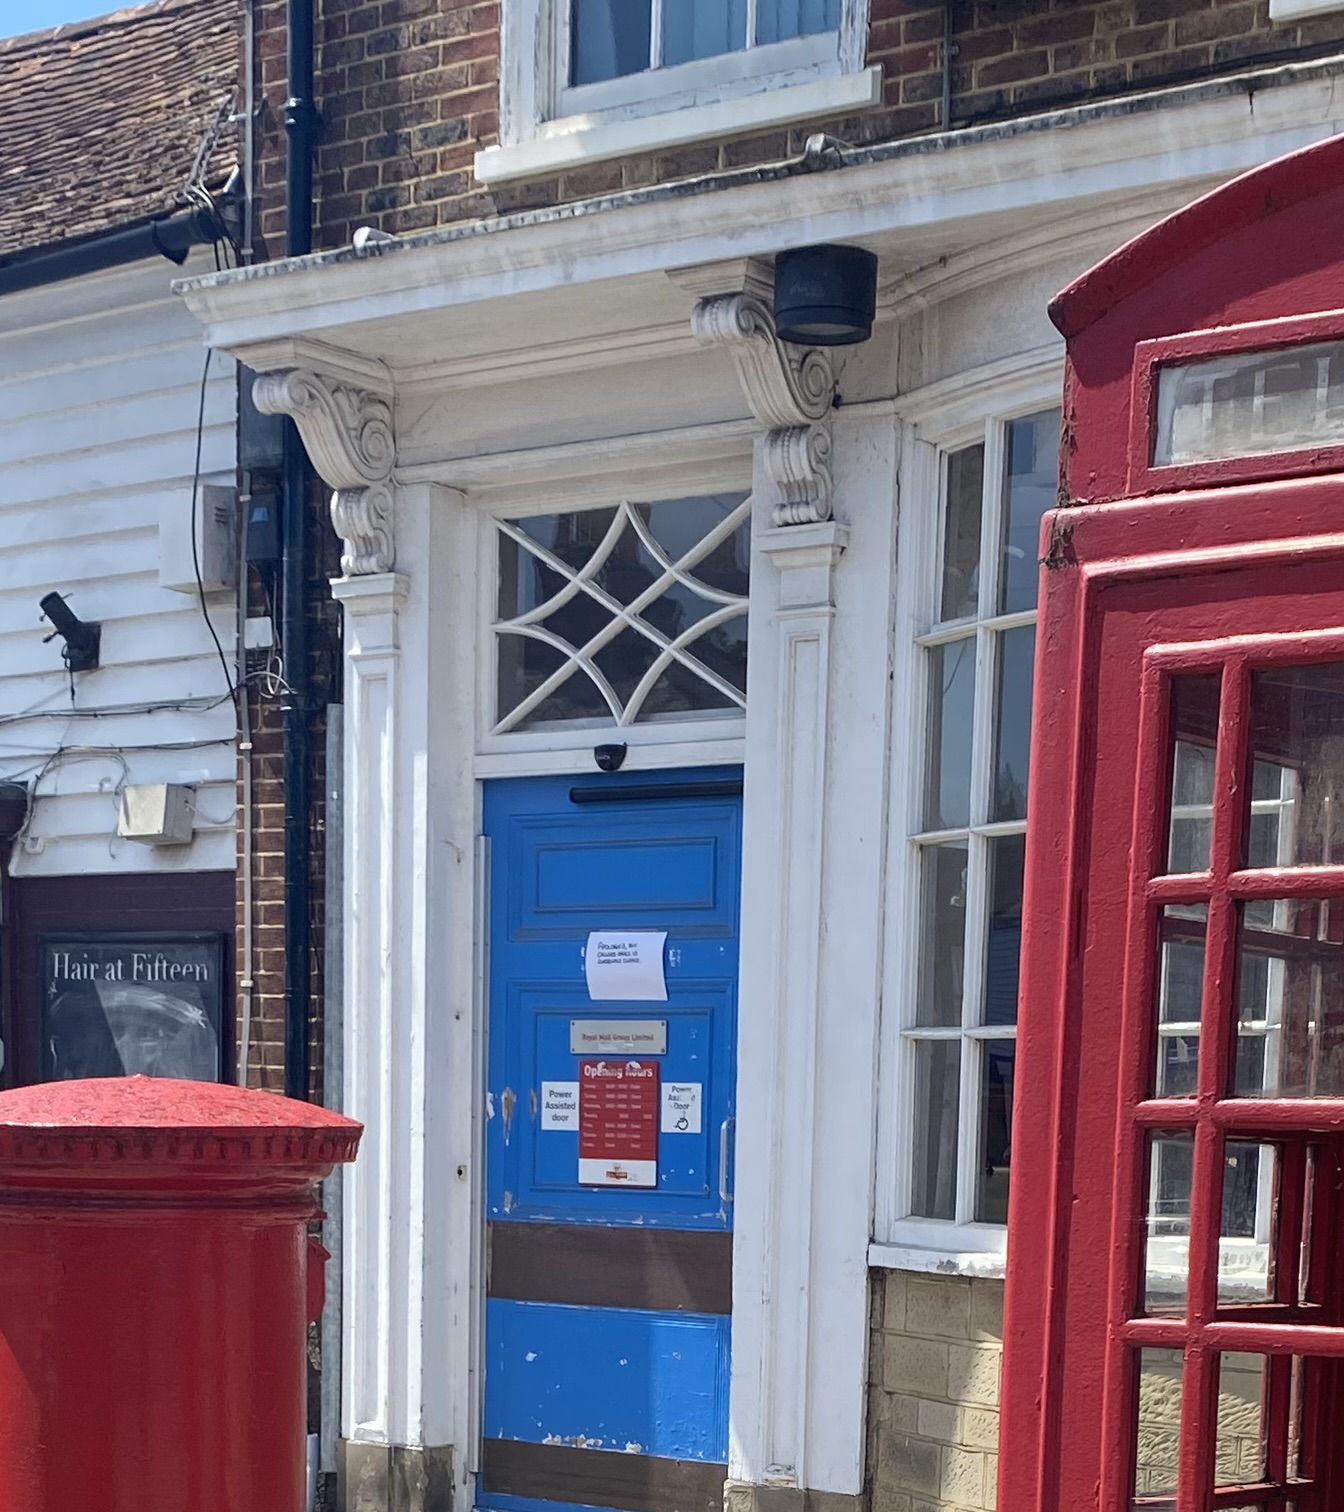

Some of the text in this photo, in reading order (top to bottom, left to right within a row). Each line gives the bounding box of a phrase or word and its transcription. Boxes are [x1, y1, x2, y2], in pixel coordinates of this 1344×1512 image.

[54, 953, 208, 981] Hair at Fifteen
[581, 1032, 654, 1043] Royal Mail Group Limited
[549, 1090, 572, 1098] Power
[545, 1102, 576, 1110] Assisted
